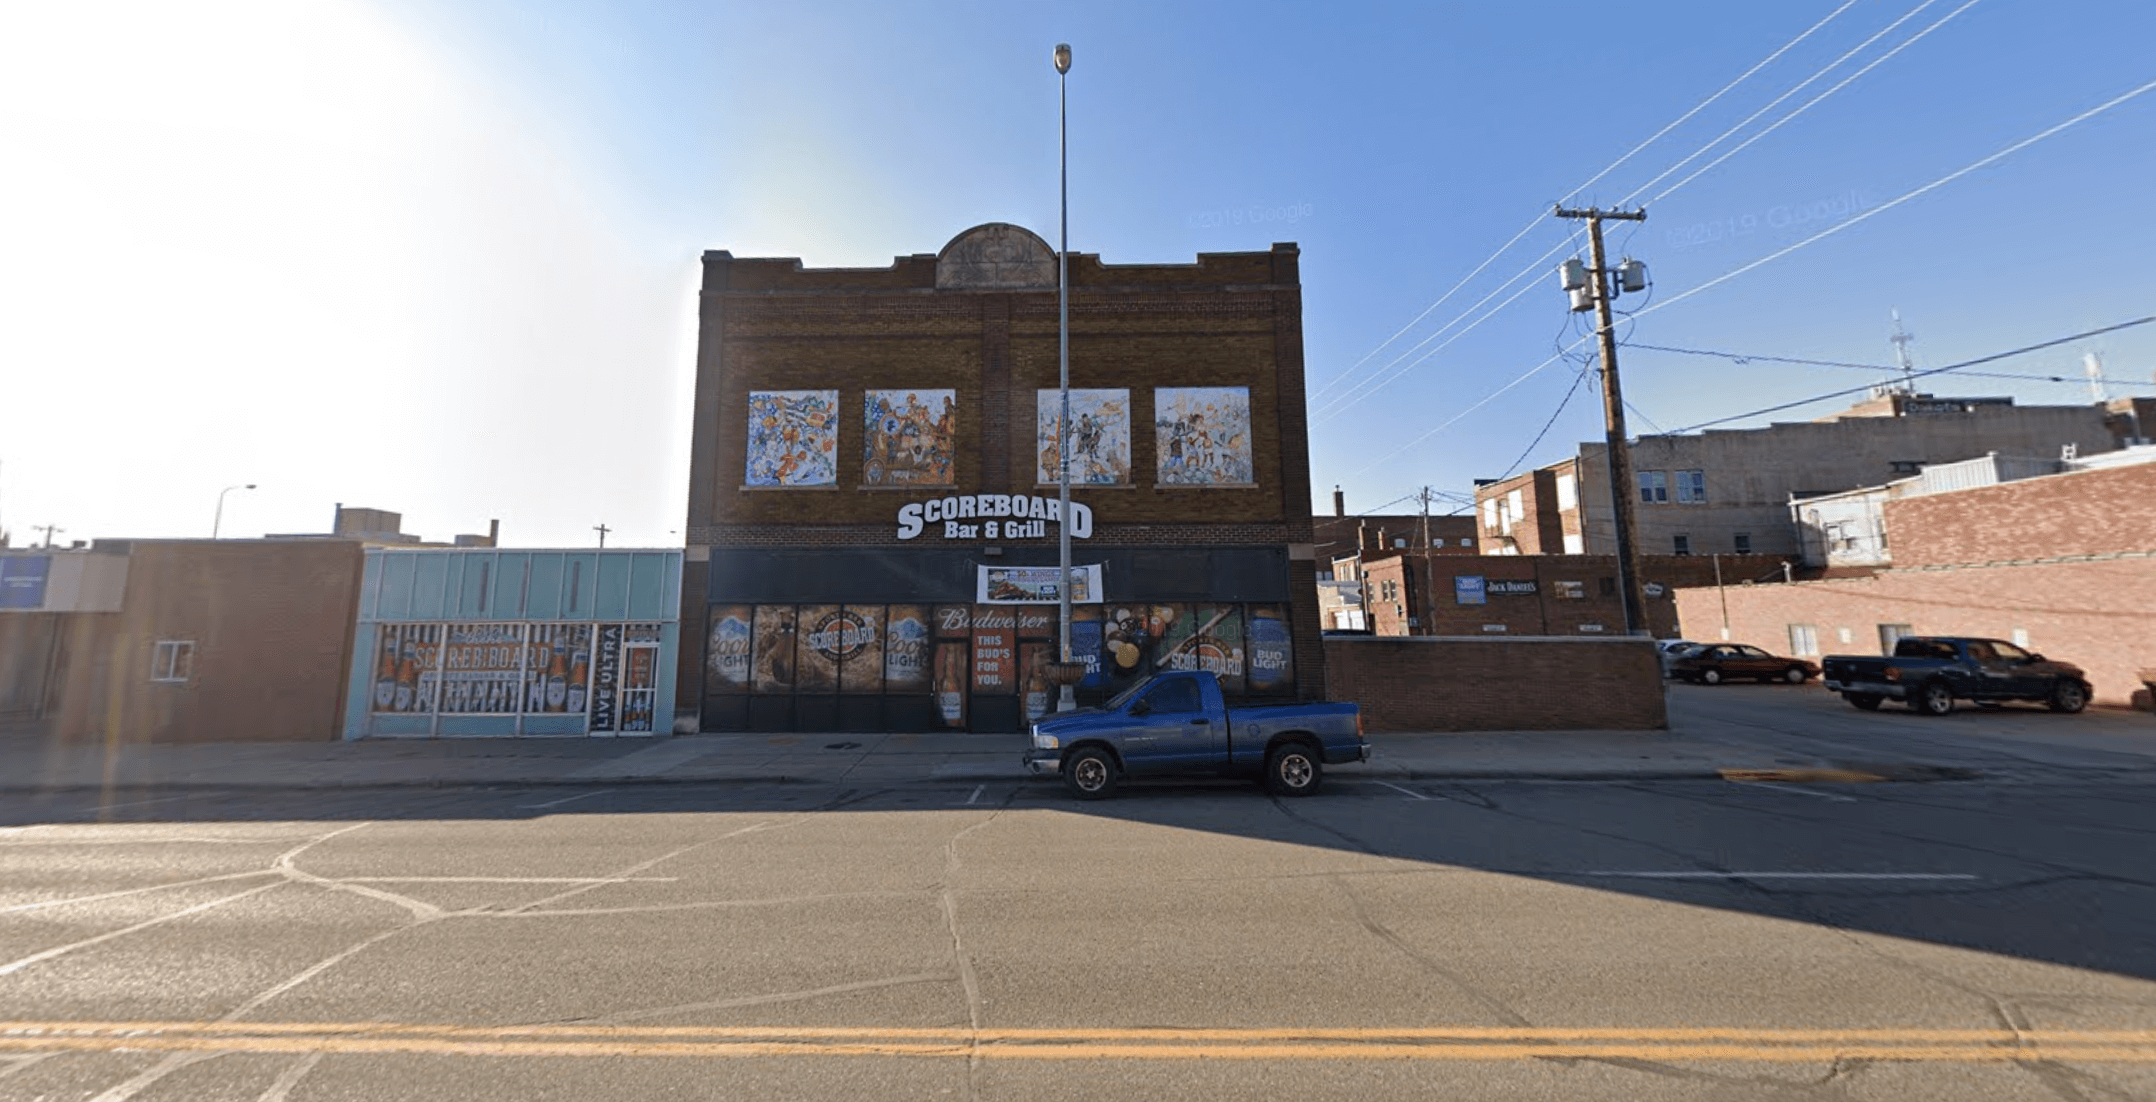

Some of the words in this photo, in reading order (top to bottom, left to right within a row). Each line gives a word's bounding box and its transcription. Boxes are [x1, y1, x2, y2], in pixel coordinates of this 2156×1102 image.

[898, 495, 1093, 539] SCOREBOARD
[944, 521, 979, 538] Bar
[985, 521, 998, 538] &
[1005, 520, 1045, 538] Grill
[937, 608, 1051, 630] Budweiser
[809, 627, 876, 650] SCOREBOARD
[977, 635, 1003, 646] THIS
[601, 627, 617, 684] ULTRA
[977, 648, 1011, 659] BUD'S
[1256, 650, 1283, 661] BUD
[977, 661, 999, 672] FOR
[1252, 658, 1287, 670] LIGHT
[977, 673, 1003, 685] YOU.
[596, 689, 612, 729] LIVE
